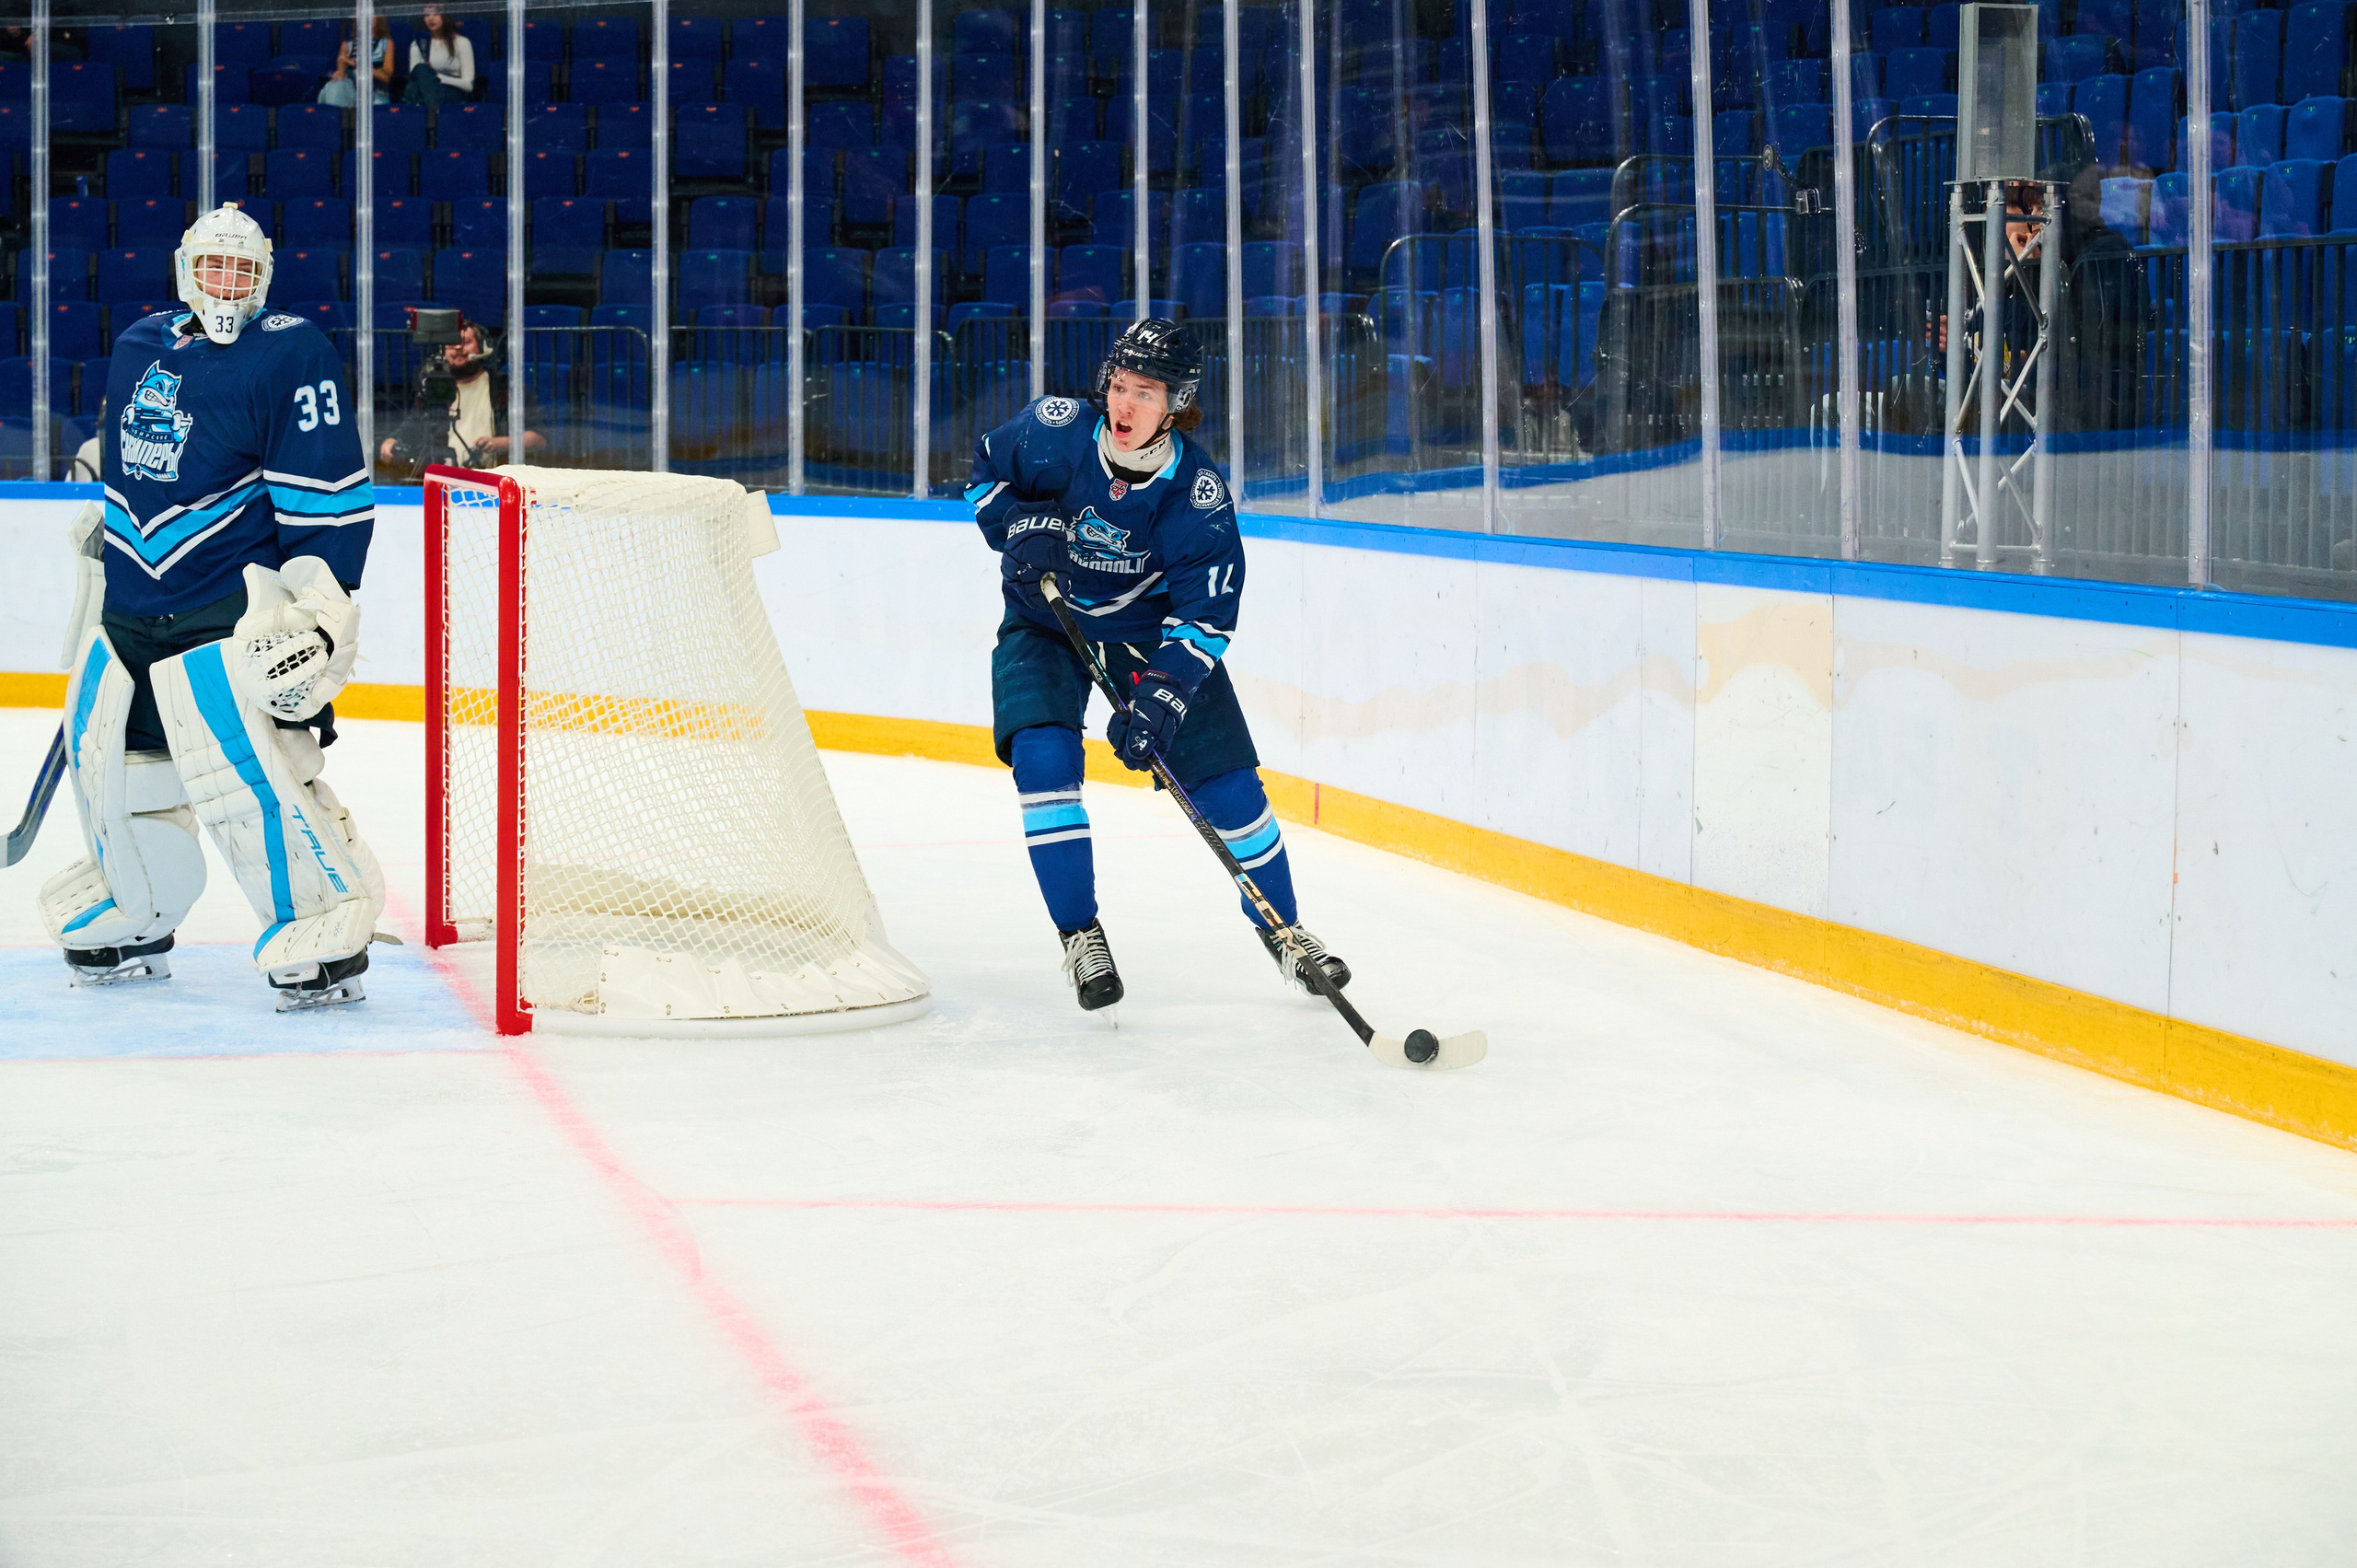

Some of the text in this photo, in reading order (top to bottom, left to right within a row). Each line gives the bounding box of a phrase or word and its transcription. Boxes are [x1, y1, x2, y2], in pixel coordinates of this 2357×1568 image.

[215, 315, 234, 333] 33
[1136, 330, 1159, 343] 14
[294, 379, 341, 433] 33
[1140, 439, 1167, 459] CCM
[292, 803, 348, 893] TRUE
[1234, 872, 1308, 959] CCM
